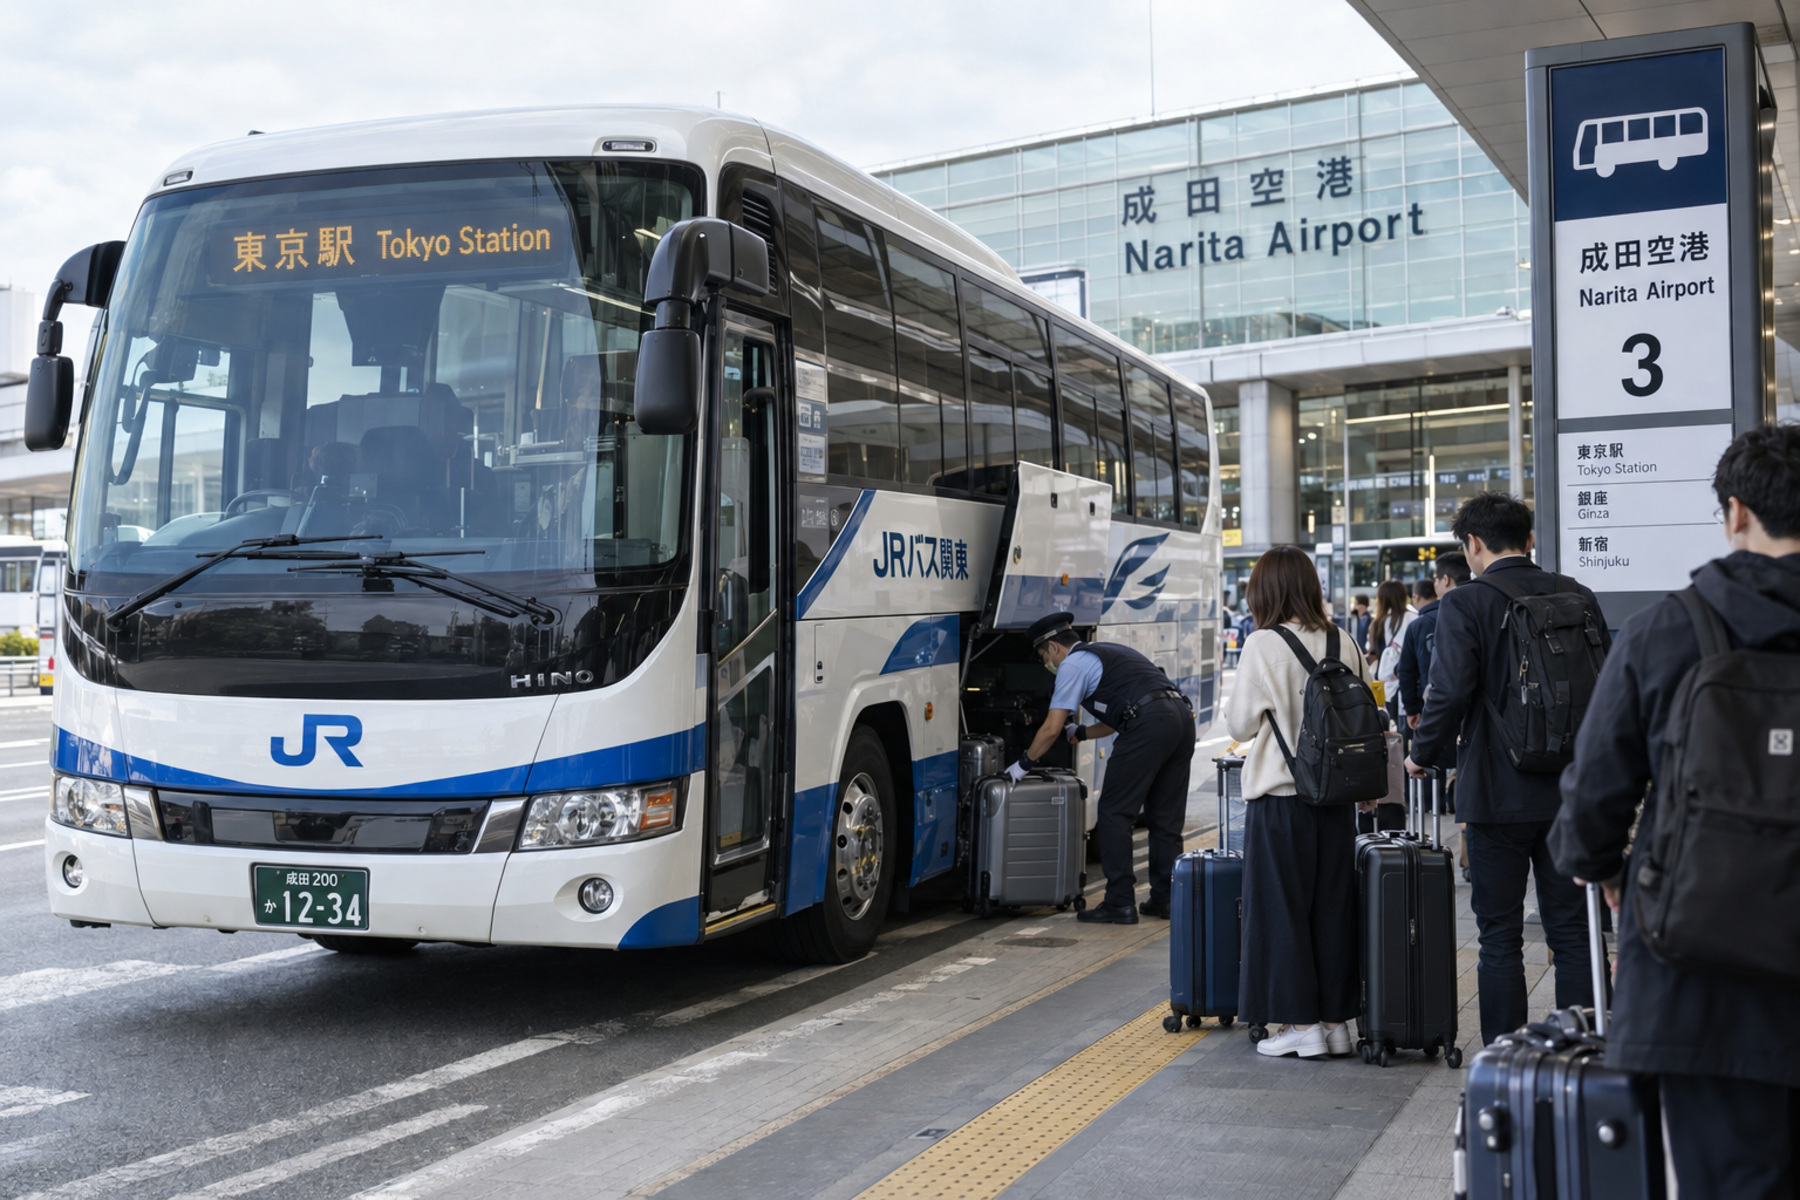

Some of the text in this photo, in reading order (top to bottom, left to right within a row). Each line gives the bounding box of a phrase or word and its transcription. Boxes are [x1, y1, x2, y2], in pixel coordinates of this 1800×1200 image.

[1122, 156, 1353, 227] 成田空港
[233, 223, 551, 273] 東京駅 Tokyo Station
[1125, 202, 1425, 274] Narita Airport
[1579, 230, 1710, 274] 成田空港
[1579, 276, 1715, 307] Narita Airport
[1621, 332, 1664, 398] 3
[1577, 442, 1624, 460] 東京駅
[1577, 461, 1657, 477] Tokyo Station
[1577, 490, 1609, 506] 銀座
[1577, 507, 1610, 520] Ginza
[873, 531, 969, 580] JRバス関東
[1578, 536, 1609, 552] 新宿
[1579, 555, 1630, 570] Shinjuku
[510, 669, 594, 689] HINO
[270, 713, 364, 768] JR
[312, 872, 338, 887] 200
[264, 890, 362, 926] か 12-34
